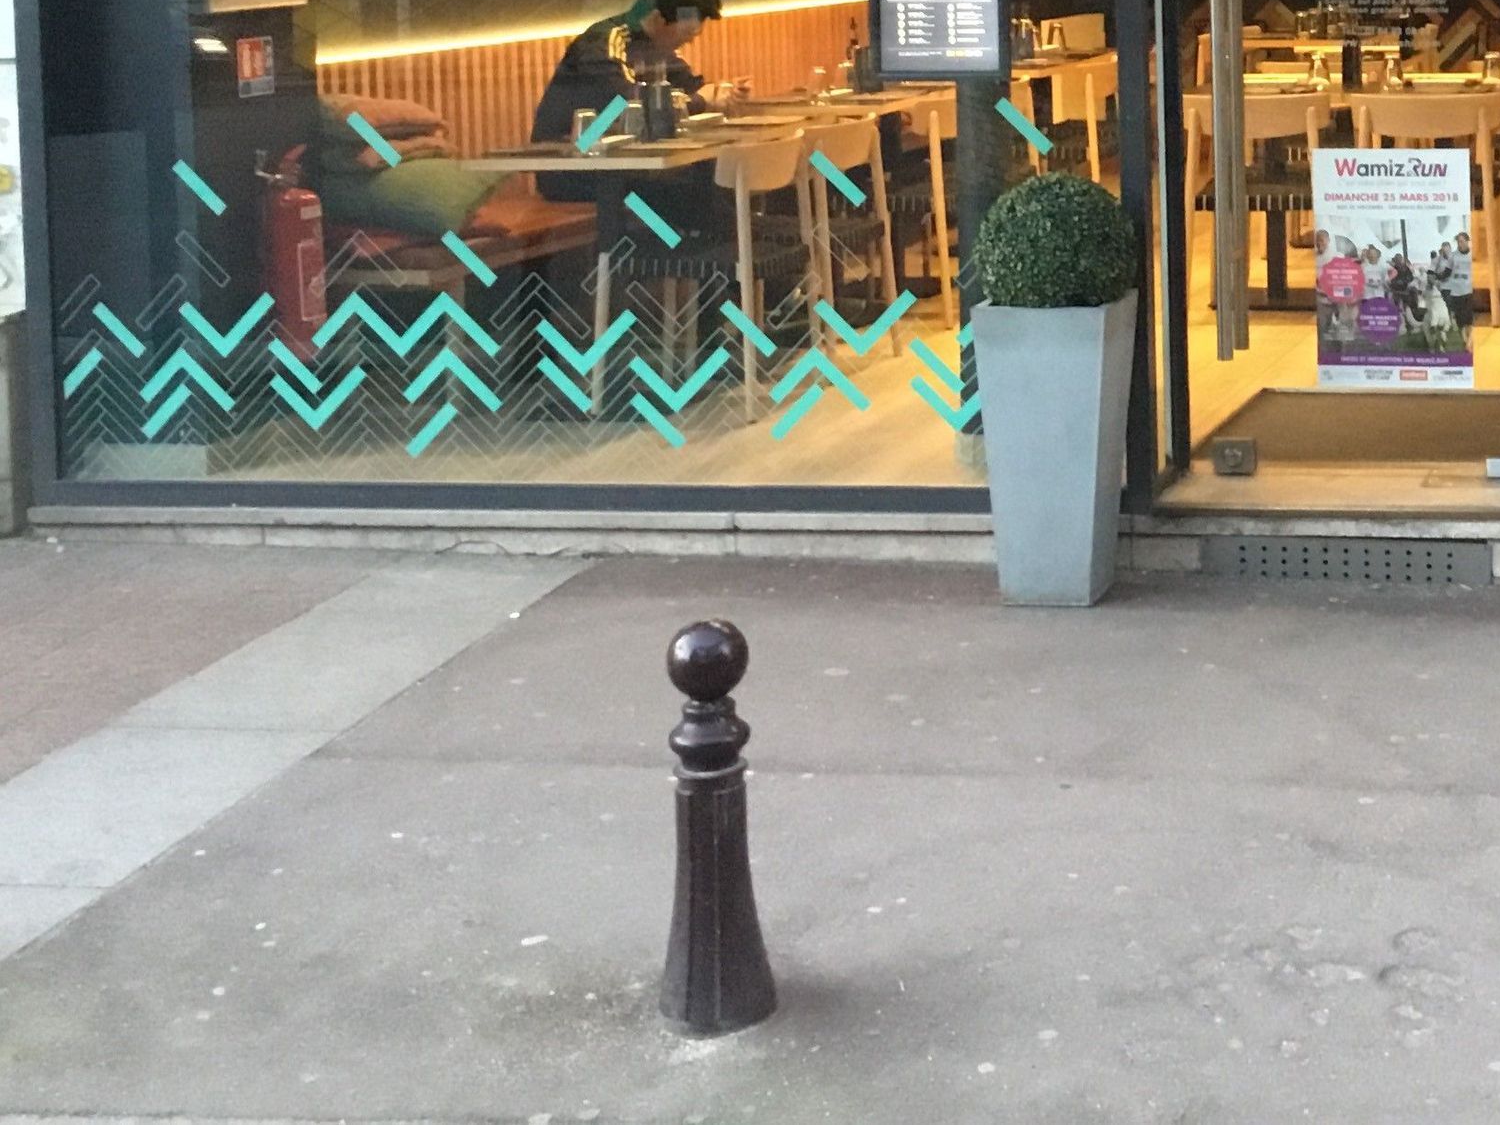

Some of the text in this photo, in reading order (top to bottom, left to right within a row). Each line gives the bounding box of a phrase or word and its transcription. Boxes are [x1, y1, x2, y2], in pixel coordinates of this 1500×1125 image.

[1324, 192, 1380, 203] DIMANCHE
[1383, 192, 1396, 203] 25
[1400, 192, 1430, 203] MARS
